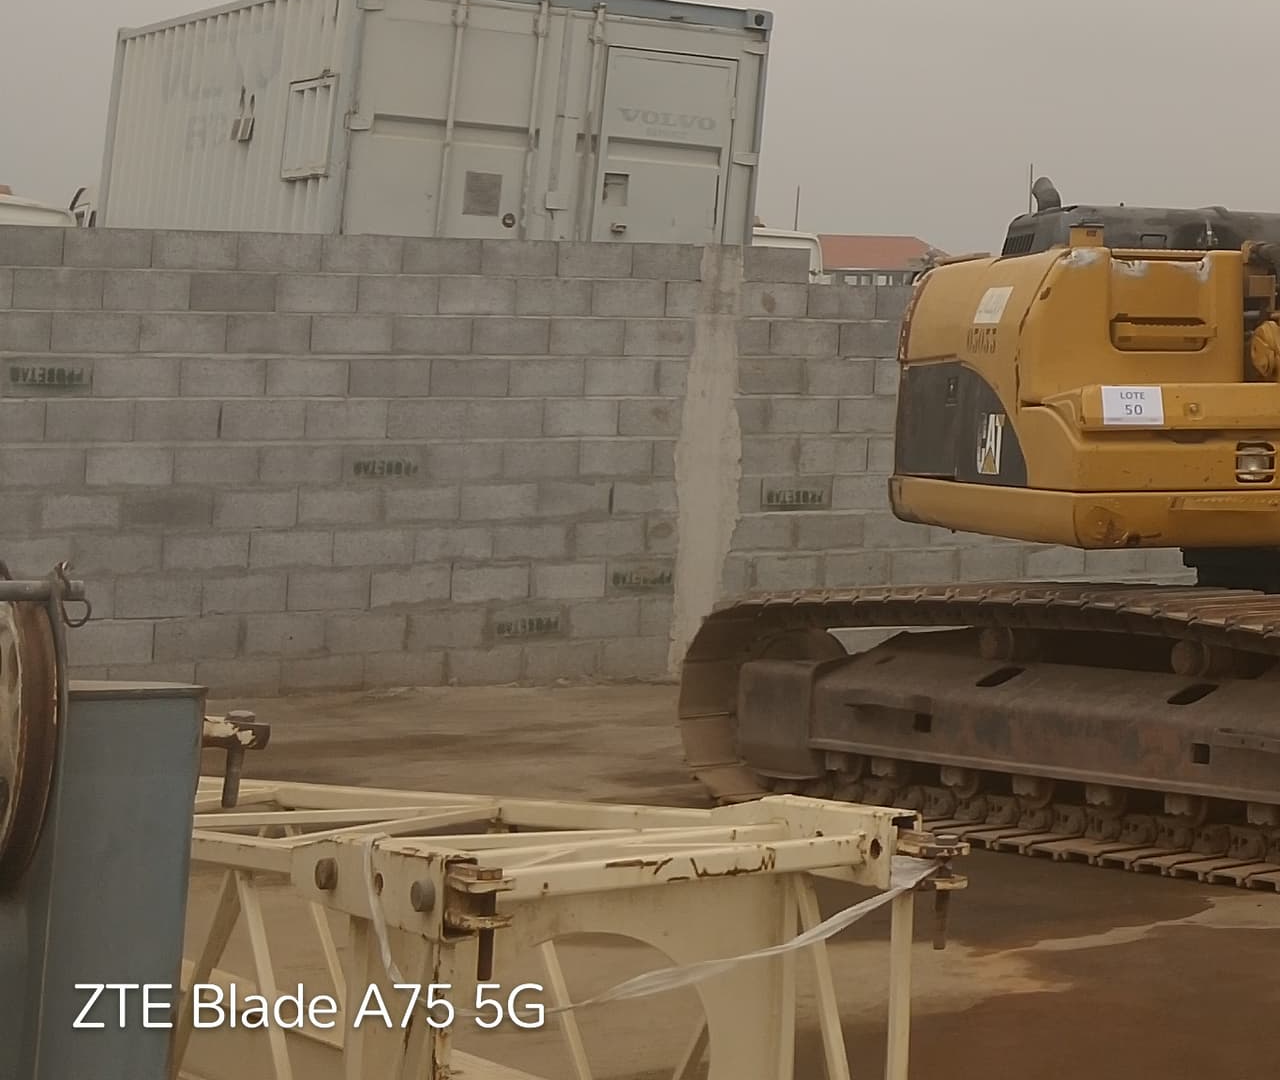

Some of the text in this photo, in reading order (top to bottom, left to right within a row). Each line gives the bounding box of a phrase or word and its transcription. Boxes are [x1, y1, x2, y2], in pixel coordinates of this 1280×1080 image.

[616, 106, 717, 130] VOLVO
[1119, 391, 1145, 400] LOTE
[1124, 404, 1143, 416] 50
